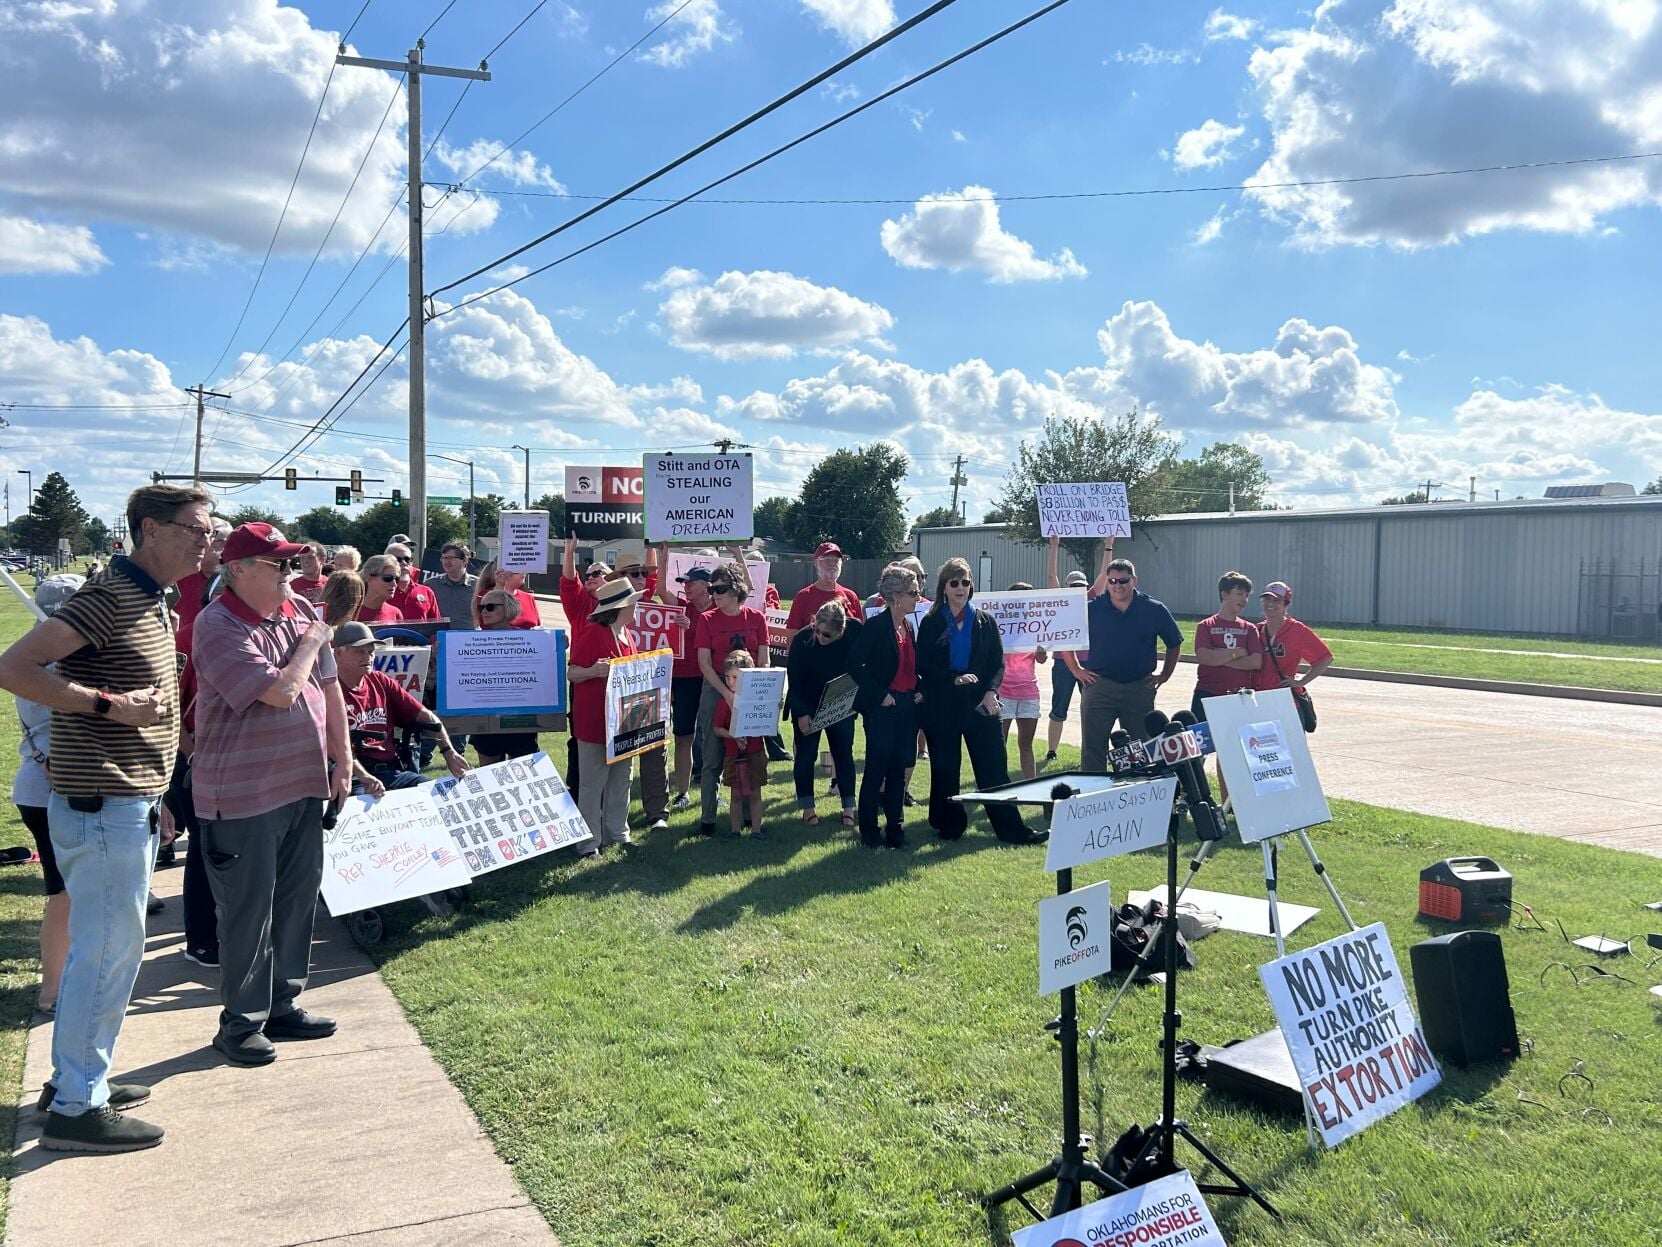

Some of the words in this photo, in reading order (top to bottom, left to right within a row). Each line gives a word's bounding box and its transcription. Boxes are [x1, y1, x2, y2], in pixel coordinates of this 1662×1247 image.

[658, 460, 684, 471] Stitt
[687, 460, 710, 471] and
[714, 459, 740, 470] OTA
[667, 477, 732, 489] STEALING
[1036, 484, 1067, 496] TROLL
[1071, 485, 1086, 495] ON
[1090, 483, 1124, 496] BRIDGE
[689, 494, 710, 504] our
[1055, 497, 1085, 509] BILLION
[1087, 496, 1099, 508] TO
[571, 512, 643, 524] TURNPIK
[666, 508, 734, 521] AMERICAN
[1042, 509, 1073, 522] NEVER
[1075, 510, 1105, 522] ENDING
[1108, 509, 1128, 521] TOLL
[672, 522, 731, 536] DREAMS
[1047, 523, 1088, 536] AUDIT
[1096, 523, 1127, 536] OTA
[981, 601, 999, 611] Did
[1001, 602, 1027, 613] your
[1028, 599, 1069, 612] parents
[635, 607, 675, 630] TOP
[995, 609, 1020, 619] raise
[1022, 610, 1042, 620] you
[1044, 609, 1057, 617] to
[1000, 619, 1052, 636] STROY
[1036, 628, 1081, 643] LIVES??
[458, 647, 538, 656] UNCONSTITUTIONAL
[769, 647, 788, 657] PIKE
[395, 673, 421, 693] TA
[458, 676, 539, 685] UNCONSTITUTIONAL
[612, 676, 621, 689] 69
[623, 673, 641, 686] Years
[642, 671, 649, 681] of
[614, 739, 633, 753] PEOPLE
[1165, 738, 1183, 763] 9
[1258, 752, 1279, 763] PRESS
[491, 759, 539, 786] NOT
[1253, 766, 1293, 782] CONFERENCE
[366, 807, 400, 823] WANT
[450, 818, 503, 848] THE
[501, 802, 559, 832] TOLL
[341, 829, 375, 844] SAME
[1082, 817, 1143, 853] AGAIN
[351, 841, 377, 853] GAVE
[464, 846, 497, 872] ON
[546, 816, 591, 845] BACK
[338, 862, 365, 885] REP
[368, 842, 413, 869] SHERRIE
[1054, 945, 1100, 969] PIKEOFFOTA
[1281, 957, 1326, 1016] NO
[1319, 932, 1393, 999] MORE
[1313, 1010, 1401, 1075] AUTHORITY
[1307, 1028, 1435, 1131] EXTORTION
[1086, 1201, 1170, 1242] OKLAHOMANS
[1170, 1193, 1193, 1210] FOR
